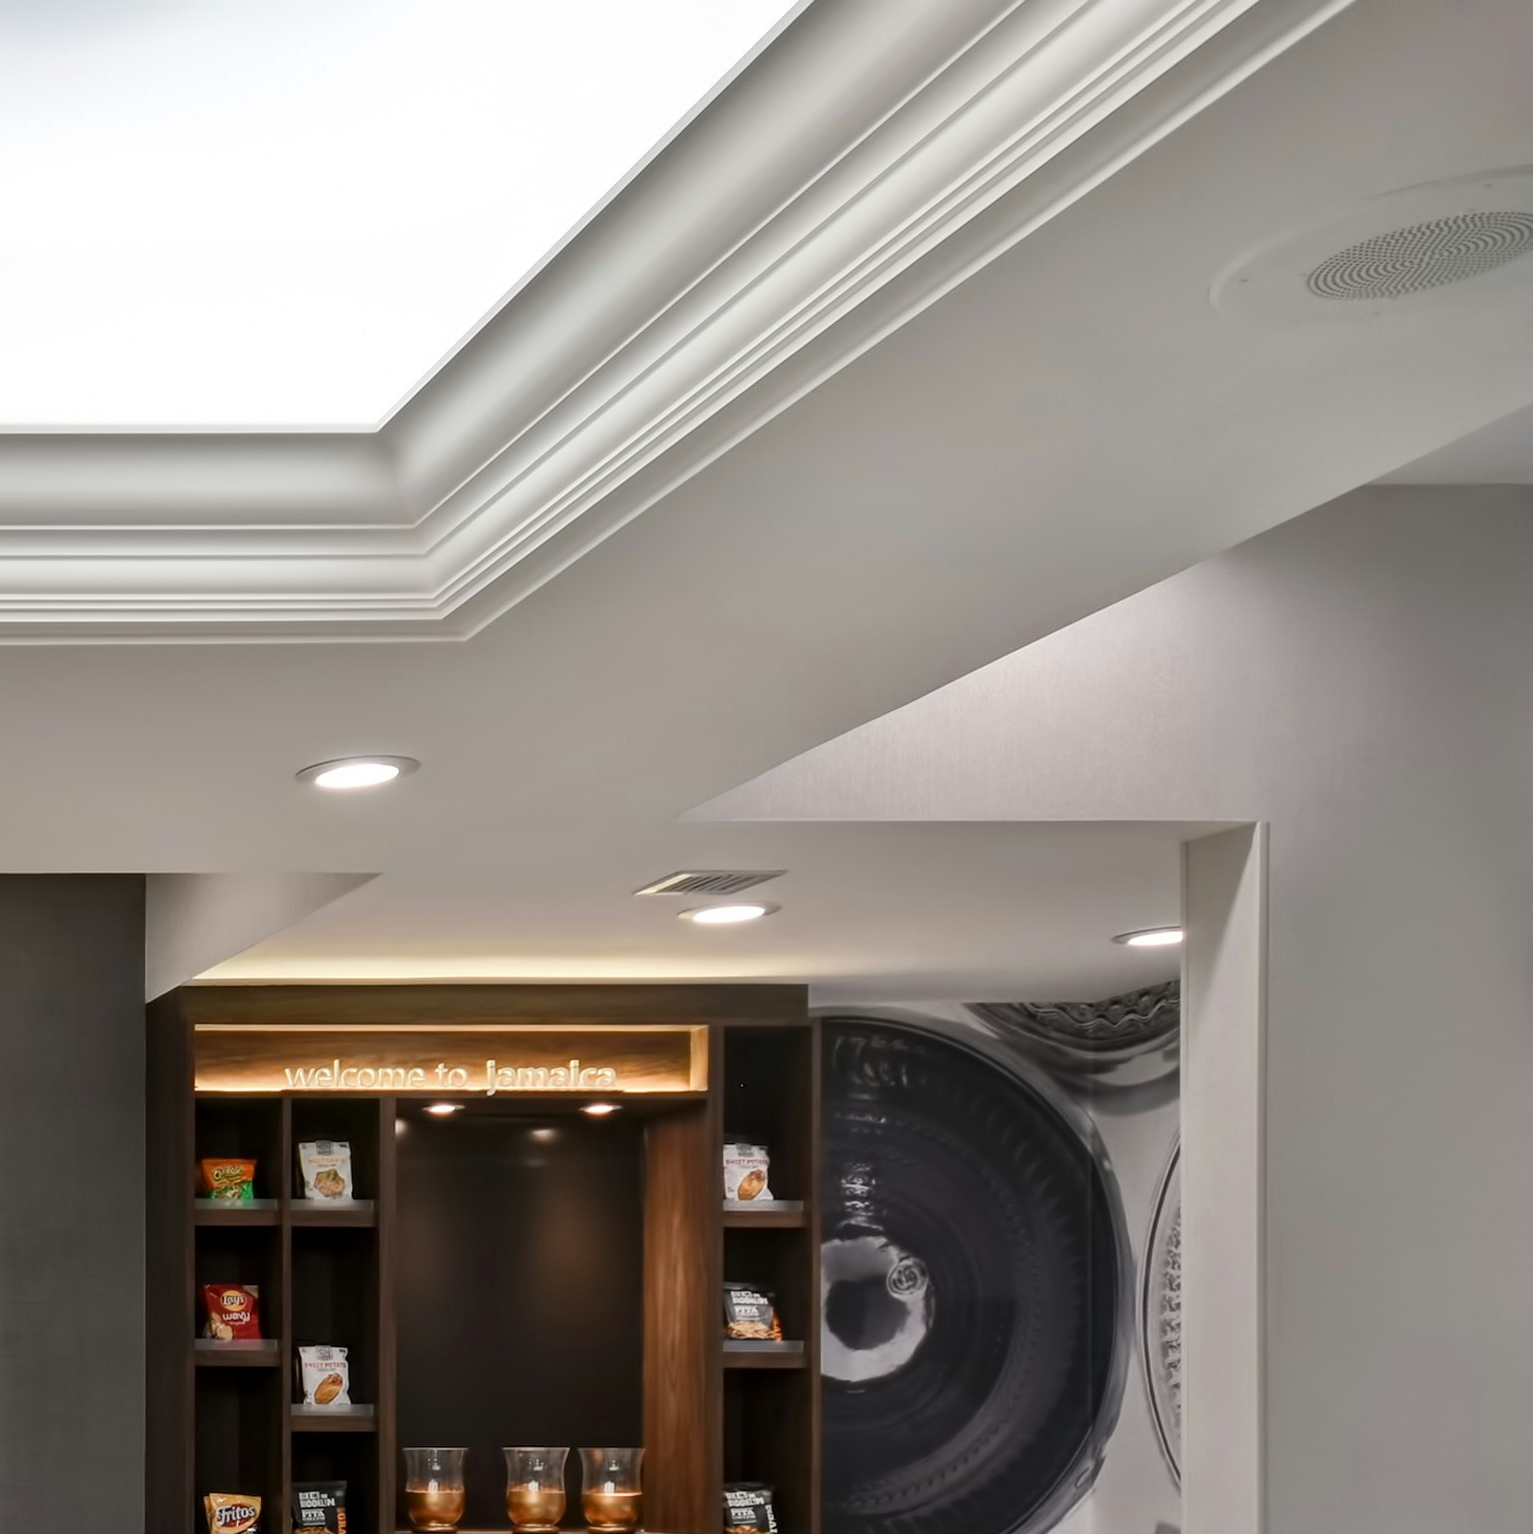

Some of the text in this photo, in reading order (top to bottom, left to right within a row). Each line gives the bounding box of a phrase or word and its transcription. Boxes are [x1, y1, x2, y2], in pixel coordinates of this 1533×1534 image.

[284, 1059, 618, 1097] welcome to jamaica
[215, 1505, 256, 1526] Fritos
